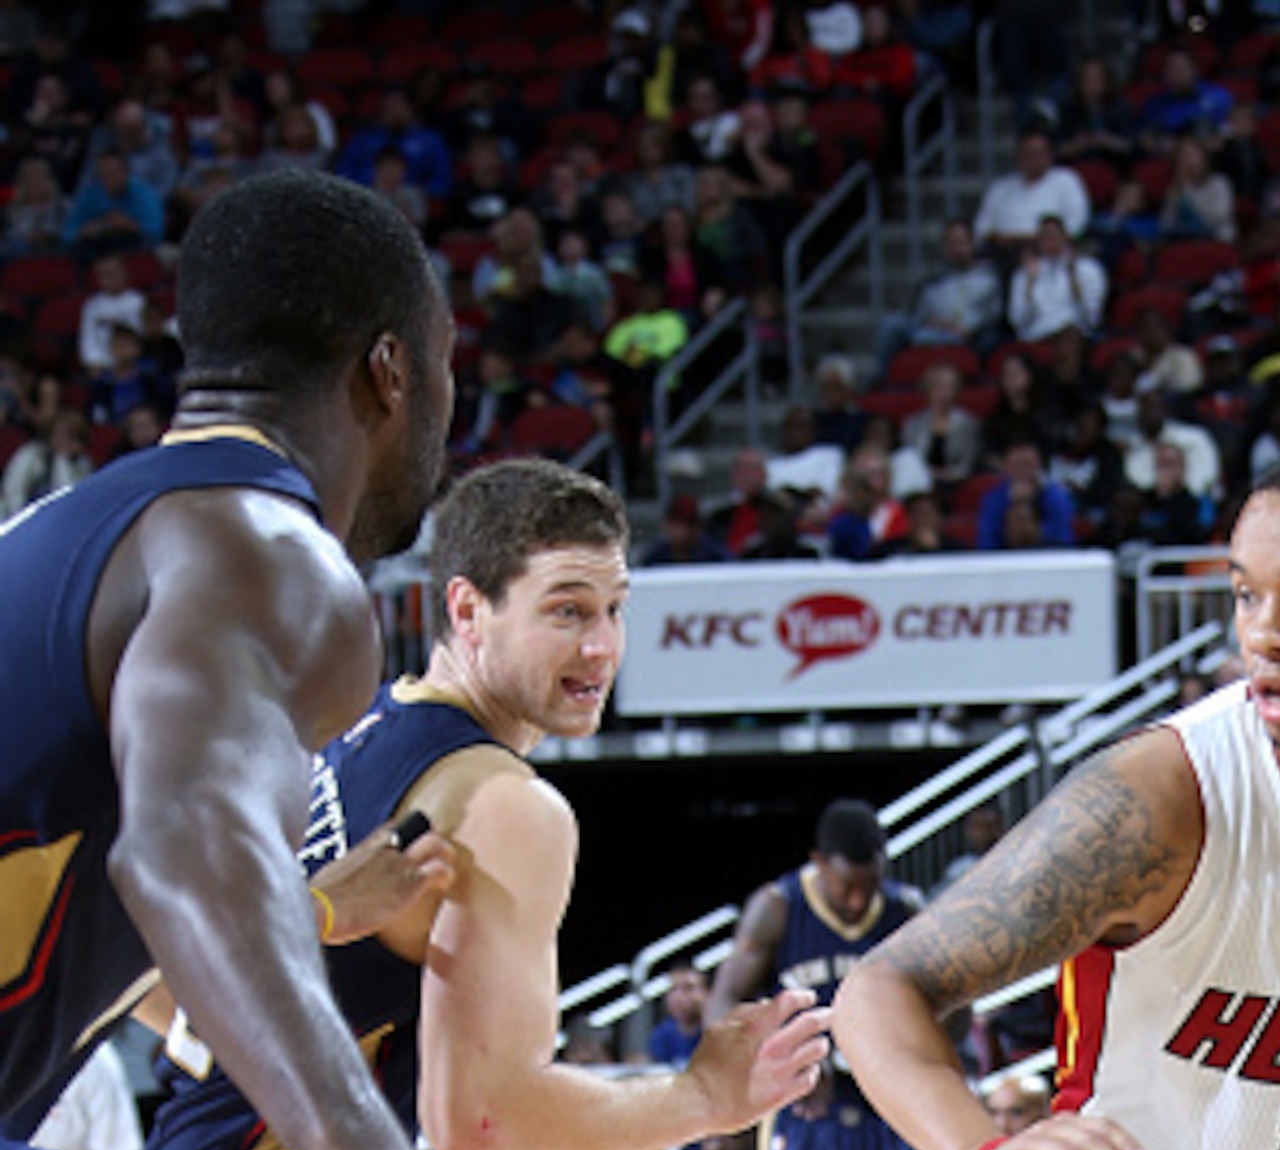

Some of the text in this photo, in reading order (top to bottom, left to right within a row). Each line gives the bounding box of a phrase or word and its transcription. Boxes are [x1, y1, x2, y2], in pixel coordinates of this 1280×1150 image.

[660, 600, 1073, 649] KFC Yum! CENTER
